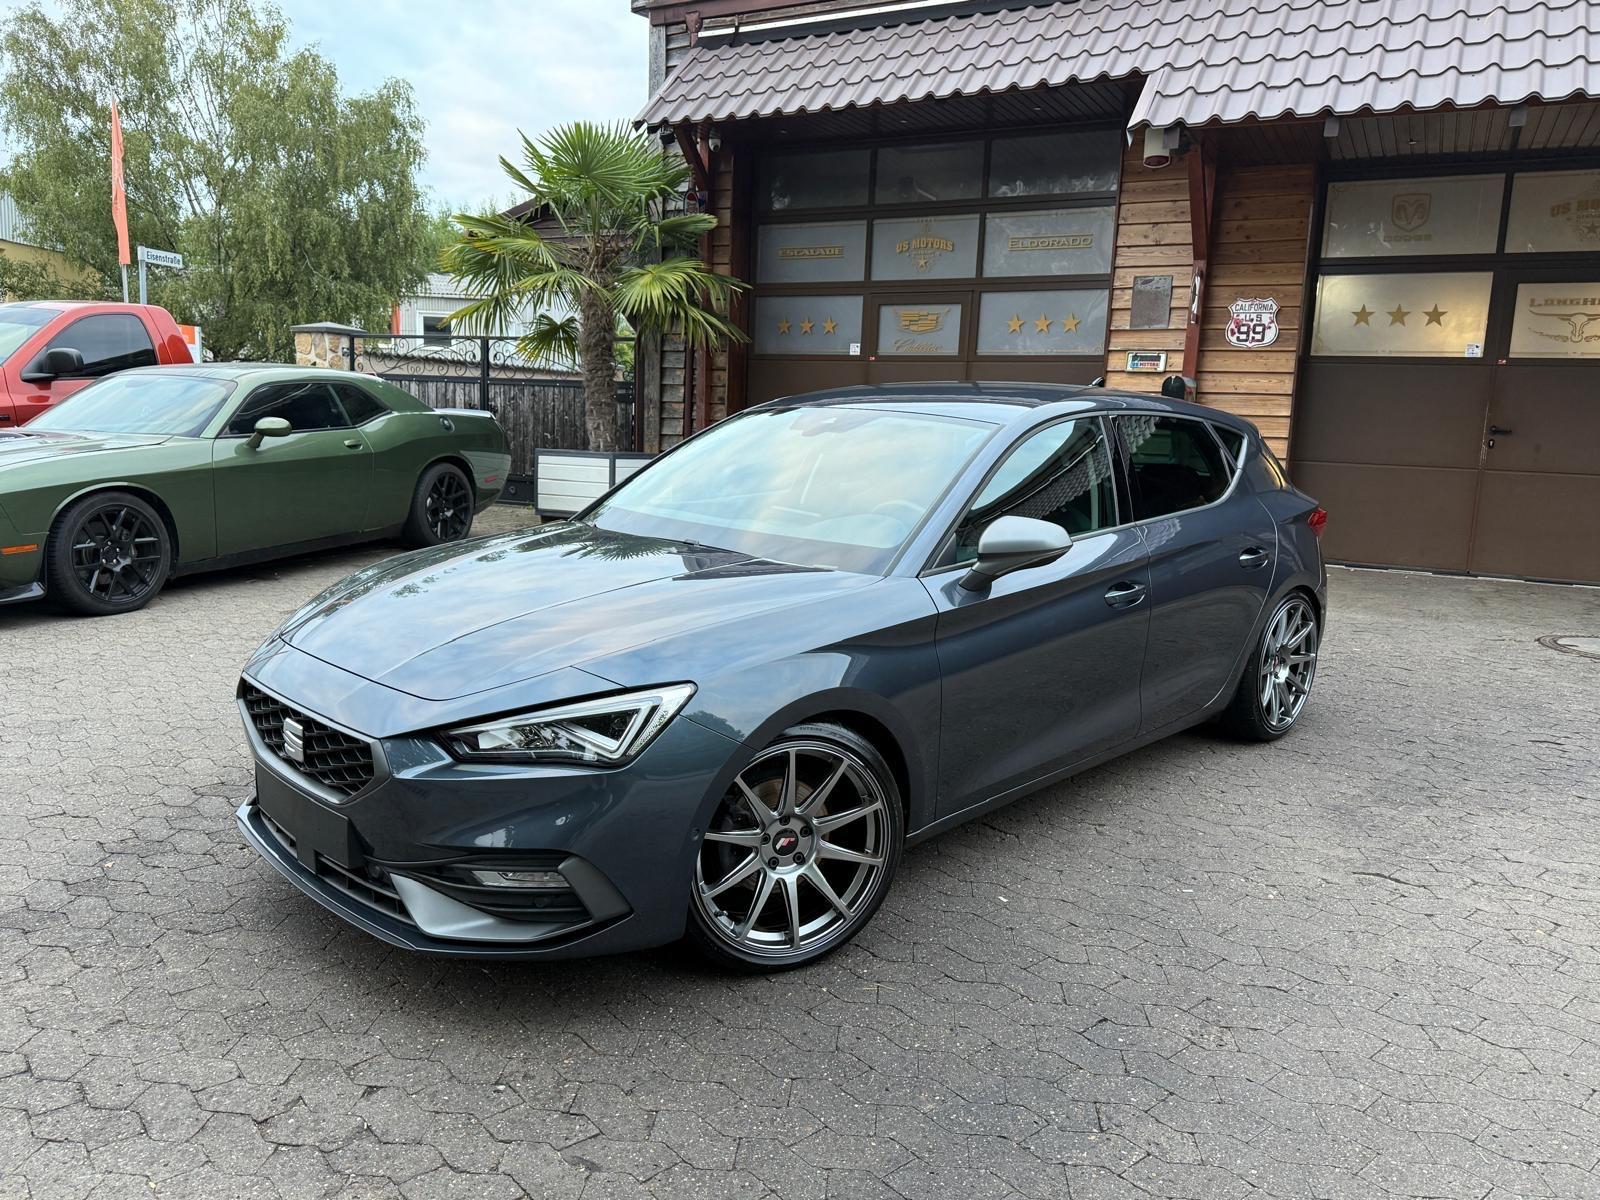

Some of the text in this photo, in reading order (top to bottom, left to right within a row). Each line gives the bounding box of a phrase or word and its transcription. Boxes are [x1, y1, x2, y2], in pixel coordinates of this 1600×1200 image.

[896, 241, 909, 253] US
[912, 238, 954, 252] MOTORS
[1008, 236, 1092, 249] ELDORADO
[146, 251, 181, 265] Eisenstraße
[779, 247, 844, 257] ESCALADE
[1235, 303, 1274, 311] CALIFORNIA
[1530, 297, 1600, 307] LONGH
[1236, 323, 1266, 342] 99
